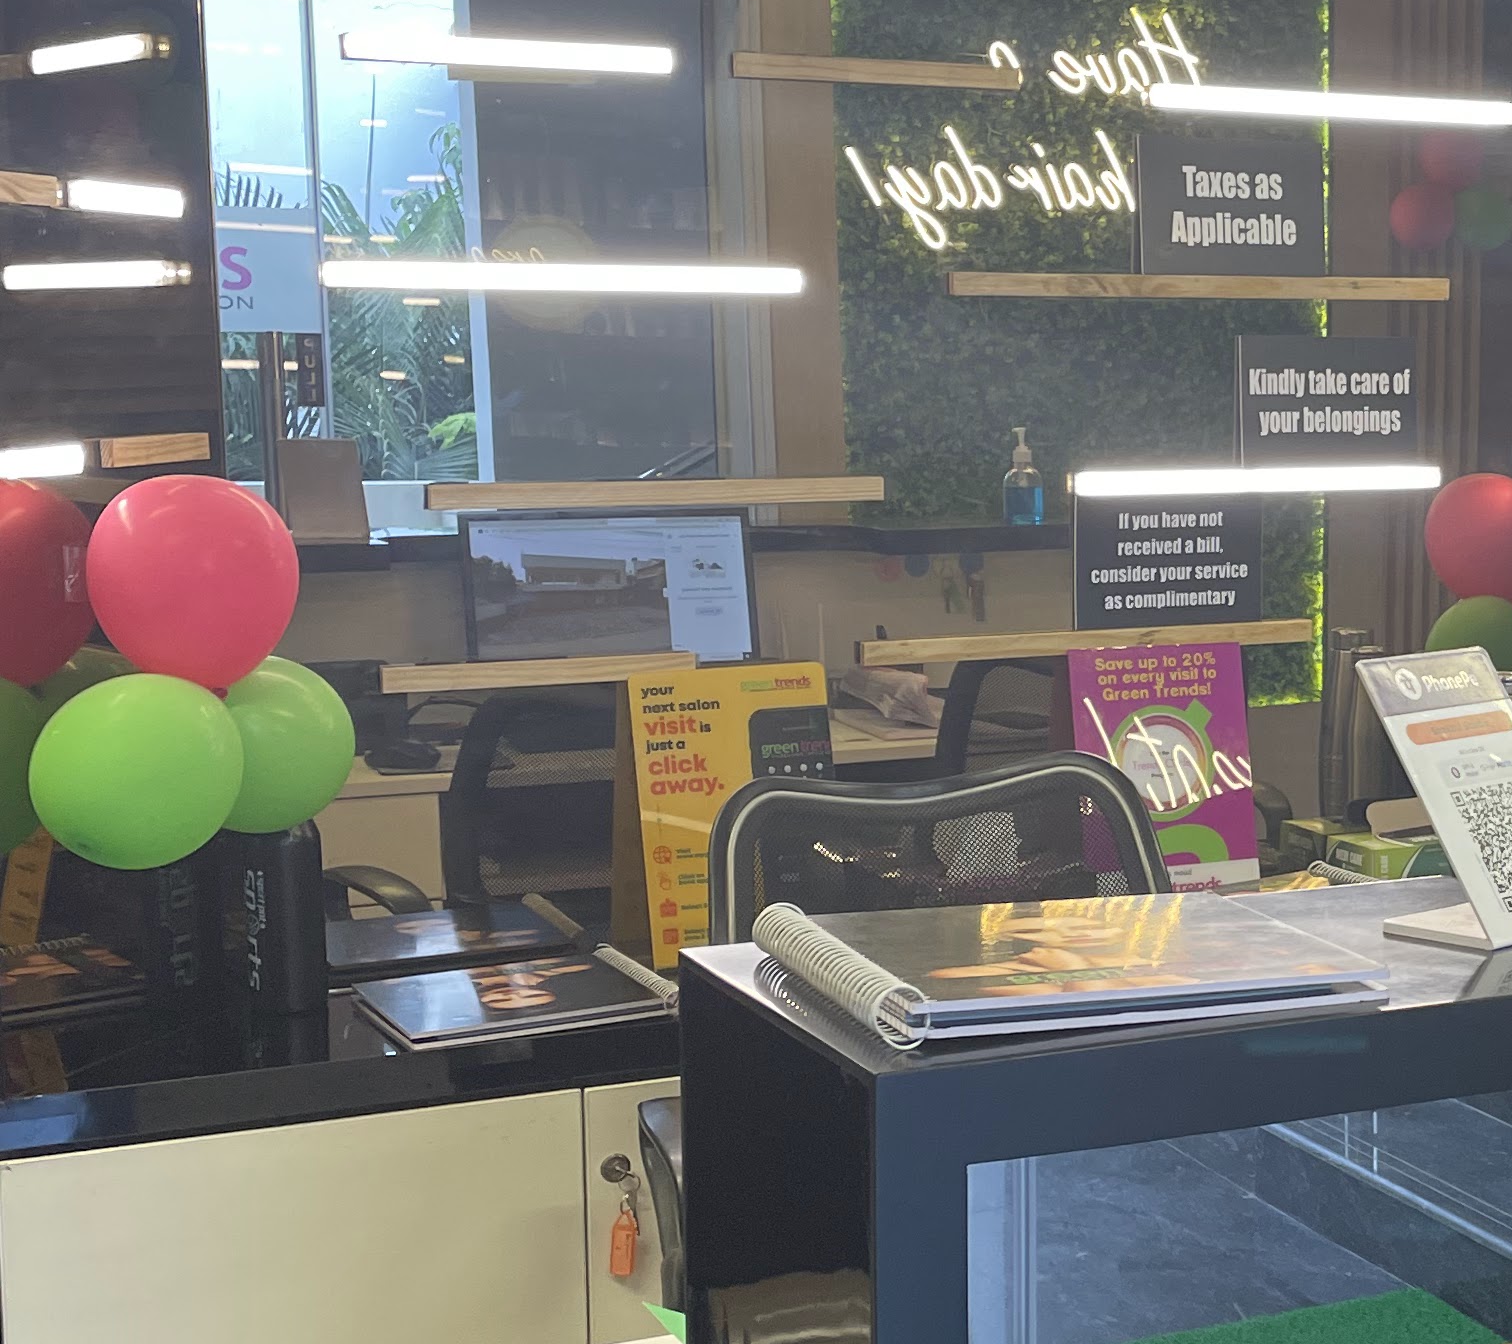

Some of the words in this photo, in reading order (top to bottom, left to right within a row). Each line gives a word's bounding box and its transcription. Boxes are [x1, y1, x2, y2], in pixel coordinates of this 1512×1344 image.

[1182, 165, 1250, 200] Taxes
[1255, 172, 1283, 200] as
[1171, 211, 1297, 247] Applicable
[1249, 368, 1305, 398] Kindly
[1308, 368, 1347, 396] take
[1350, 372, 1390, 396] care
[1393, 368, 1410, 395] of
[1260, 410, 1300, 436] your
[1303, 406, 1401, 436] belongings
[1118, 512, 1130, 530] If
[1132, 514, 1158, 531] you
[1162, 511, 1197, 529] have
[1200, 511, 1223, 528] not
[1117, 537, 1182, 556] received
[1184, 540, 1194, 554] a
[1196, 536, 1224, 554] bill,
[1090, 565, 1157, 584] consider
[1159, 566, 1193, 583] your
[1194, 561, 1249, 580] service
[1104, 594, 1122, 610] as
[1125, 589, 1236, 610] complimentary
[1094, 657, 1134, 671] Save
[1138, 657, 1158, 671] up
[1162, 655, 1177, 668] to
[1181, 651, 1216, 667] 20%
[1097, 674, 1119, 686] on
[1122, 670, 1165, 689] every
[1169, 667, 1199, 681] visit
[1203, 667, 1217, 680] to
[1421, 670, 1479, 693] PhonePe
[641, 685, 674, 702] your
[1102, 687, 1150, 702] Green
[1154, 682, 1212, 699] Trends!
[642, 701, 676, 714] next
[679, 699, 720, 712] salon
[644, 716, 696, 737] visit
[700, 720, 711, 733] is
[646, 739, 673, 754] just
[676, 739, 686, 751] a
[761, 741, 799, 758] green
[649, 754, 708, 775] click
[650, 776, 724, 797] away.
